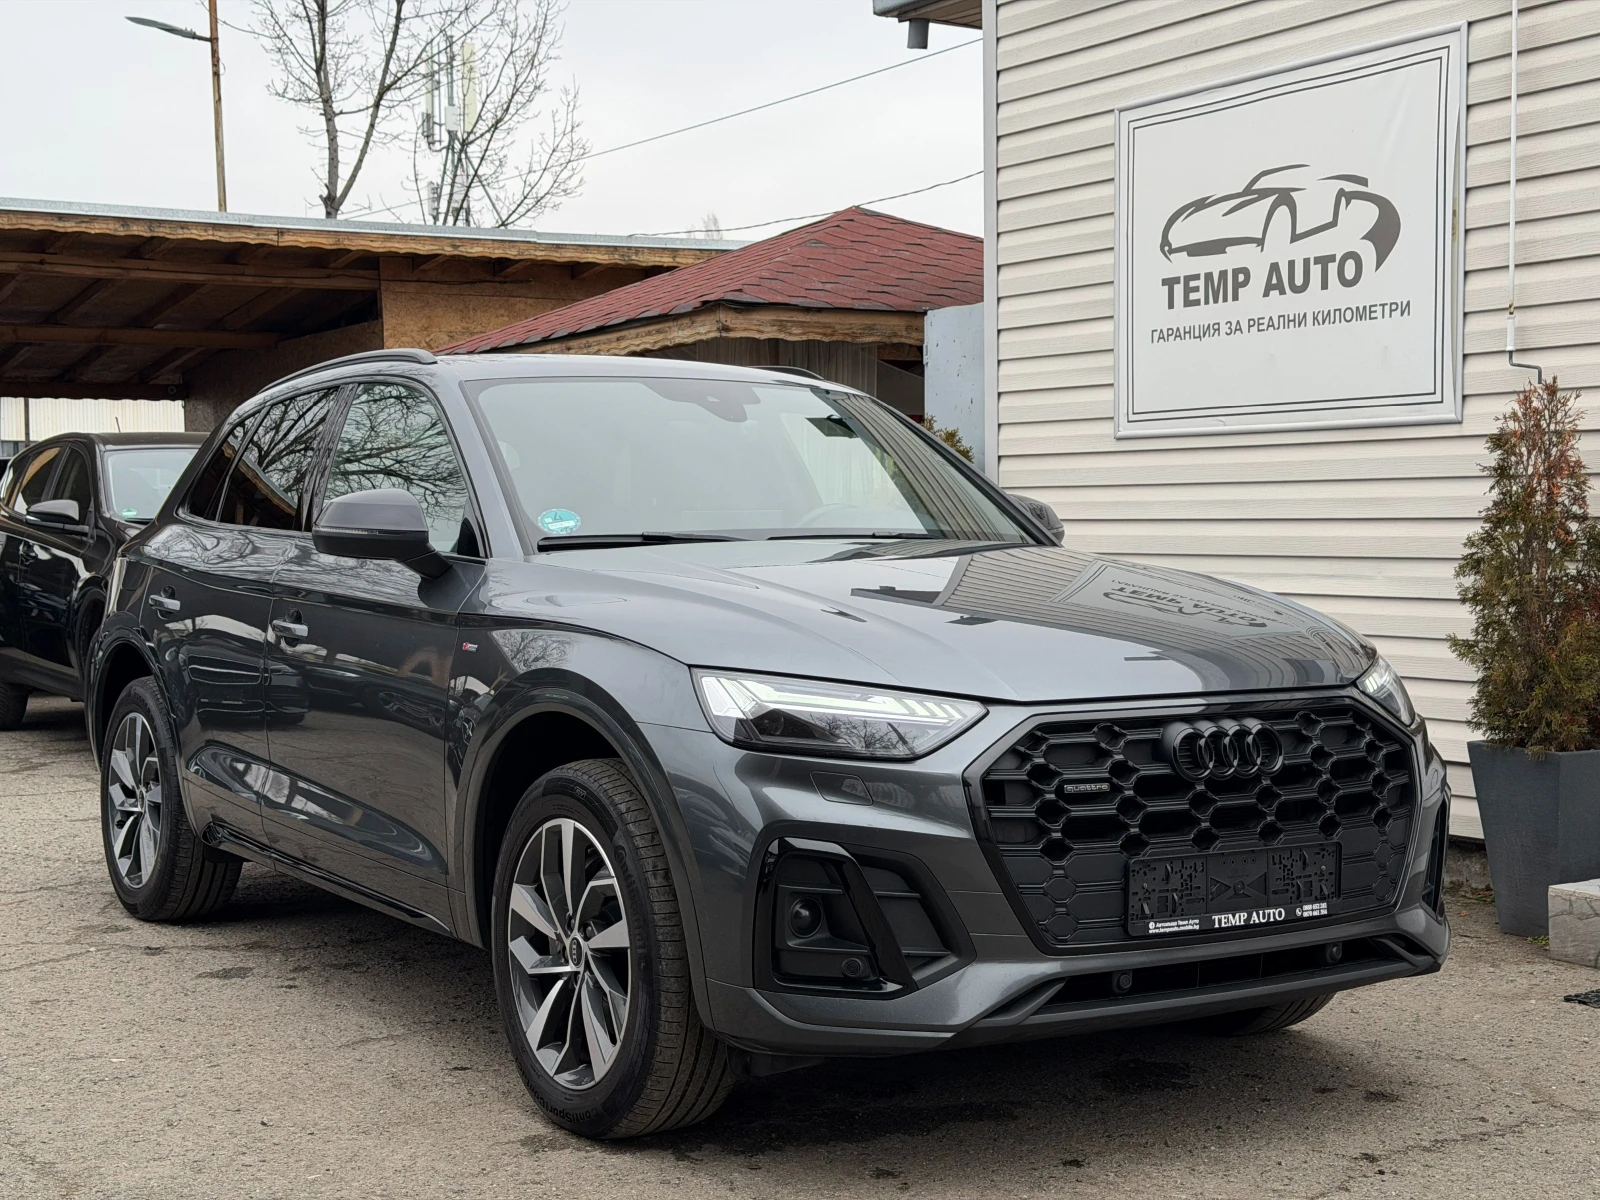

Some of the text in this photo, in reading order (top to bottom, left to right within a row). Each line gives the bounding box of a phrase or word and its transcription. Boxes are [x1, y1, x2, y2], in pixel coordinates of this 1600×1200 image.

[1161, 250, 1363, 310] TEMP AUTO
[1151, 300, 1411, 344] ГАРАНЦИЯ ЗА РЕАЛНИ КИЛОМЕТРИ
[1066, 784, 1108, 793] quattro
[1212, 908, 1286, 928] TEMP AUTO
